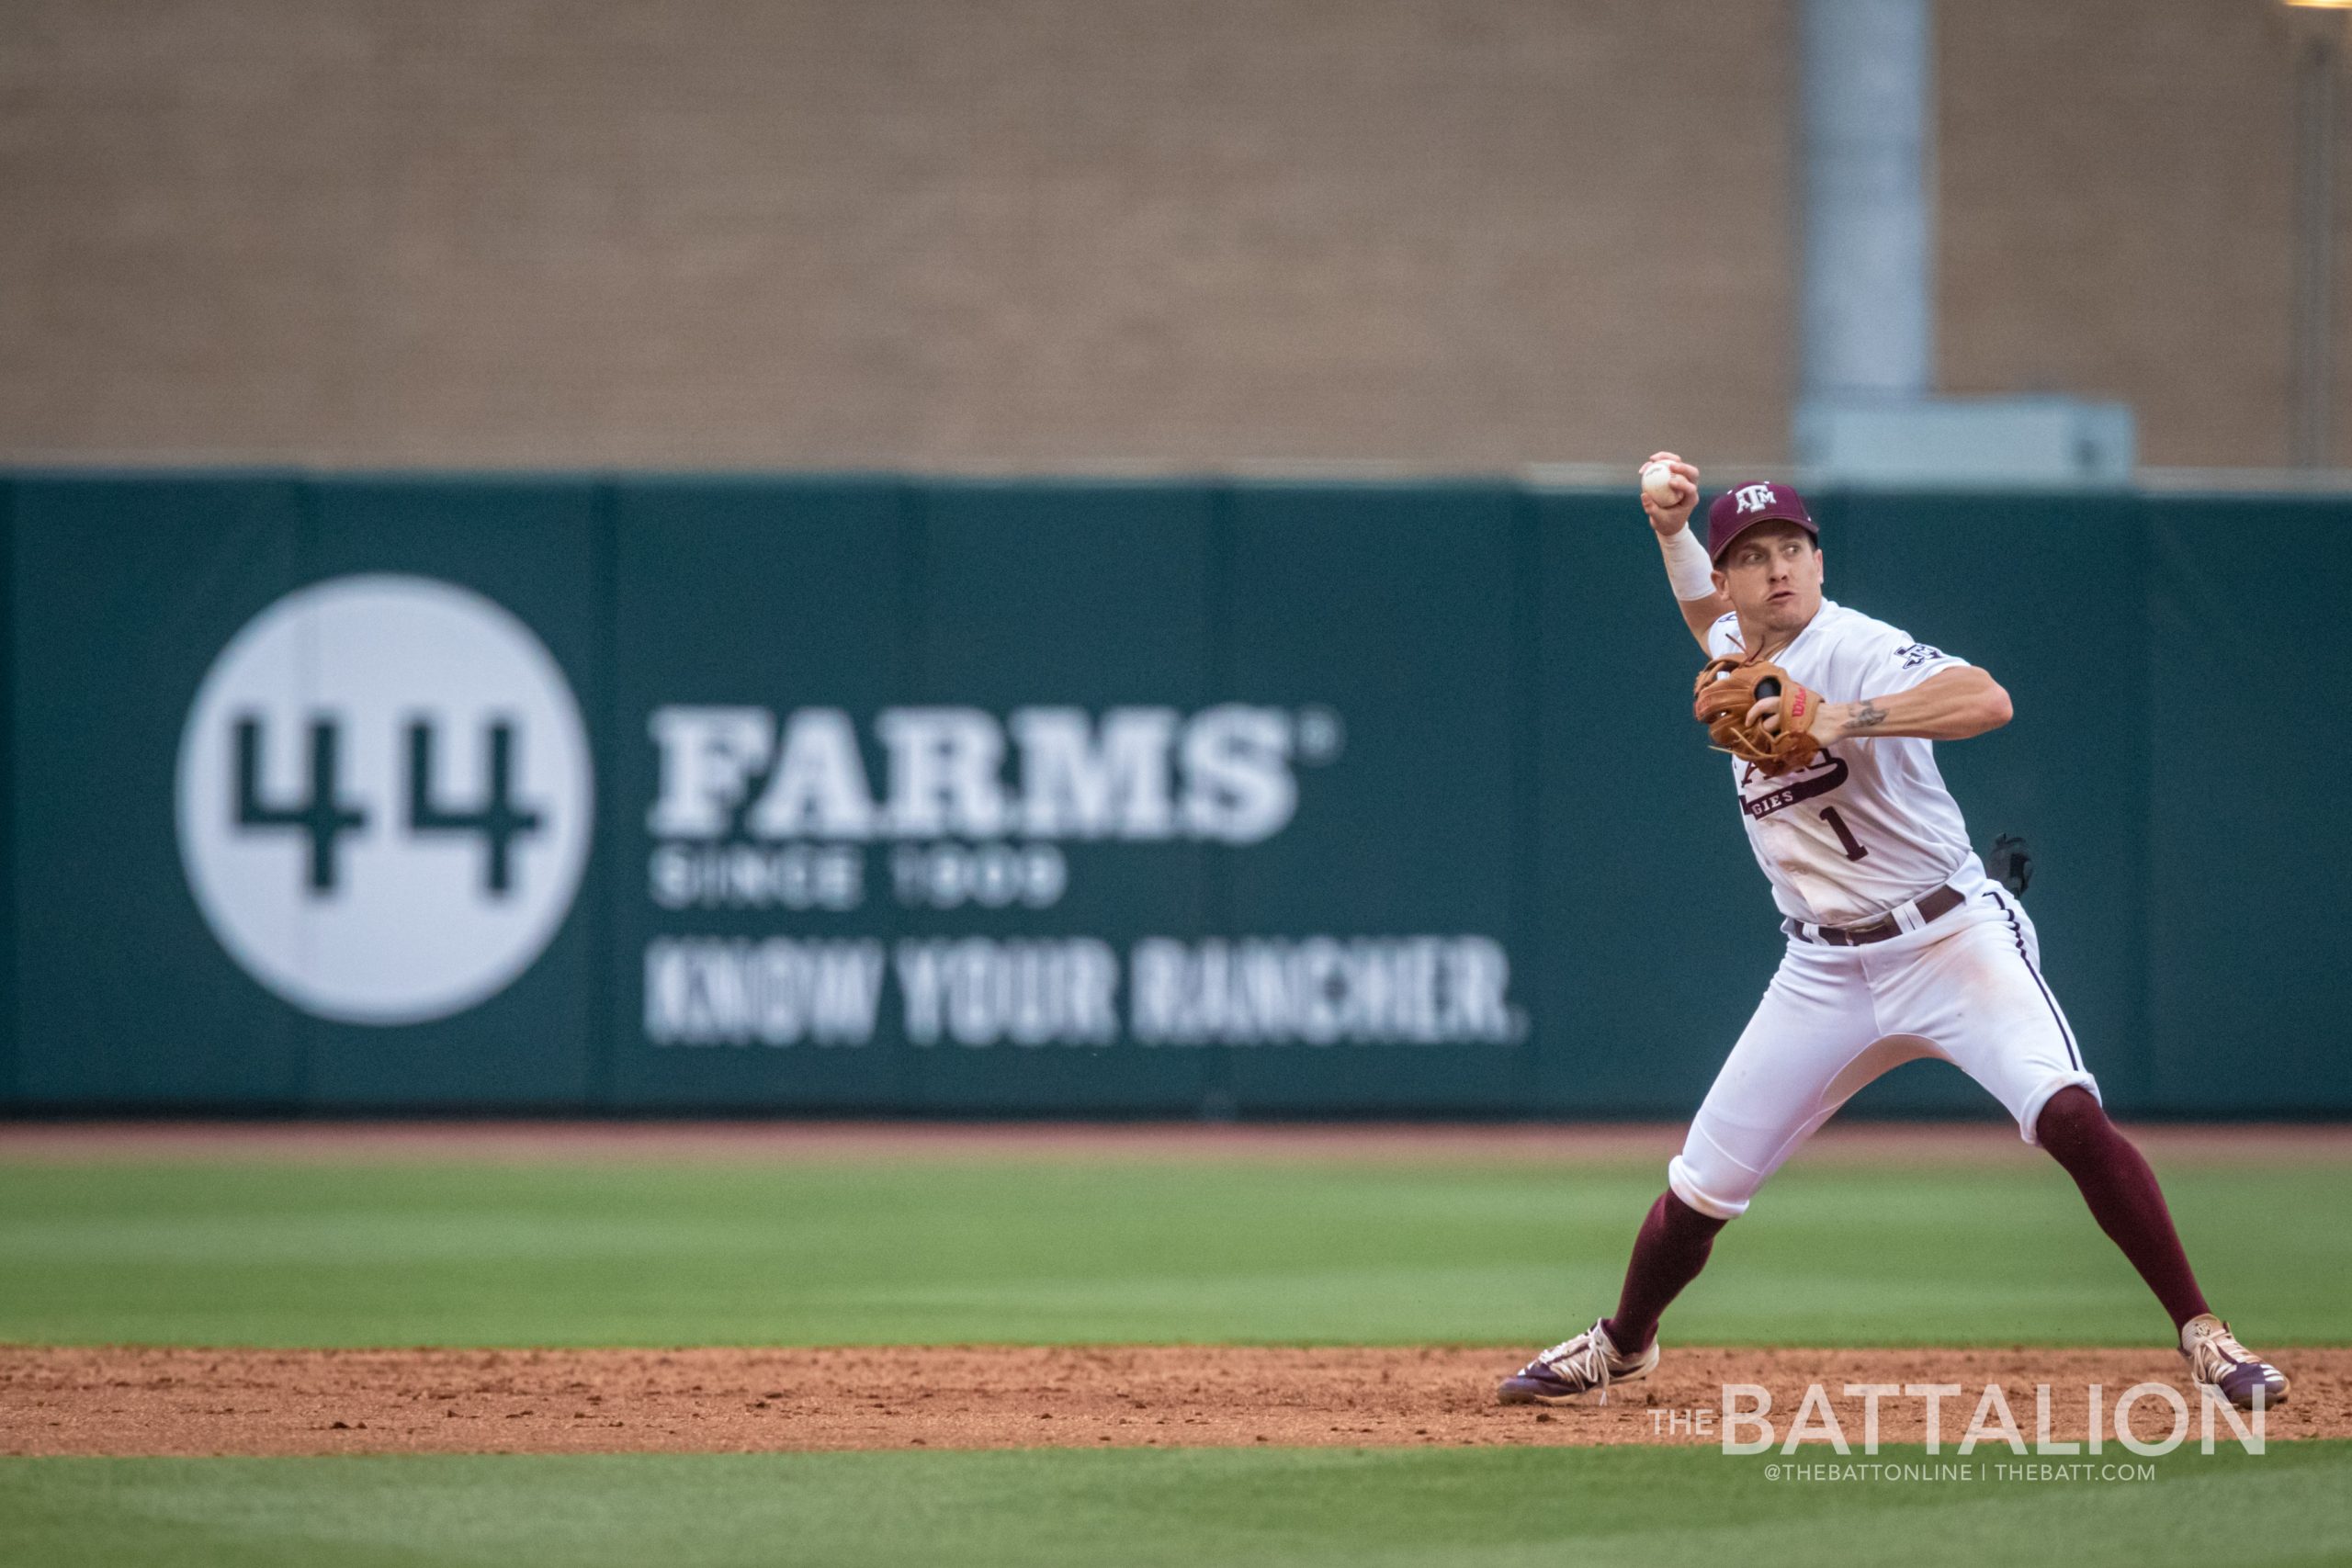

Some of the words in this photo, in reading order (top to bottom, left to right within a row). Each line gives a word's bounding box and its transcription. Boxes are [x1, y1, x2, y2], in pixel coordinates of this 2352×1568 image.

[231, 714, 550, 897] 44
[1750, 789, 1793, 817] GIES
[1819, 806, 1869, 862] 1
[650, 843, 863, 909] SINCE
[644, 937, 885, 1045] KNOW
[894, 937, 1119, 1045] YOUR
